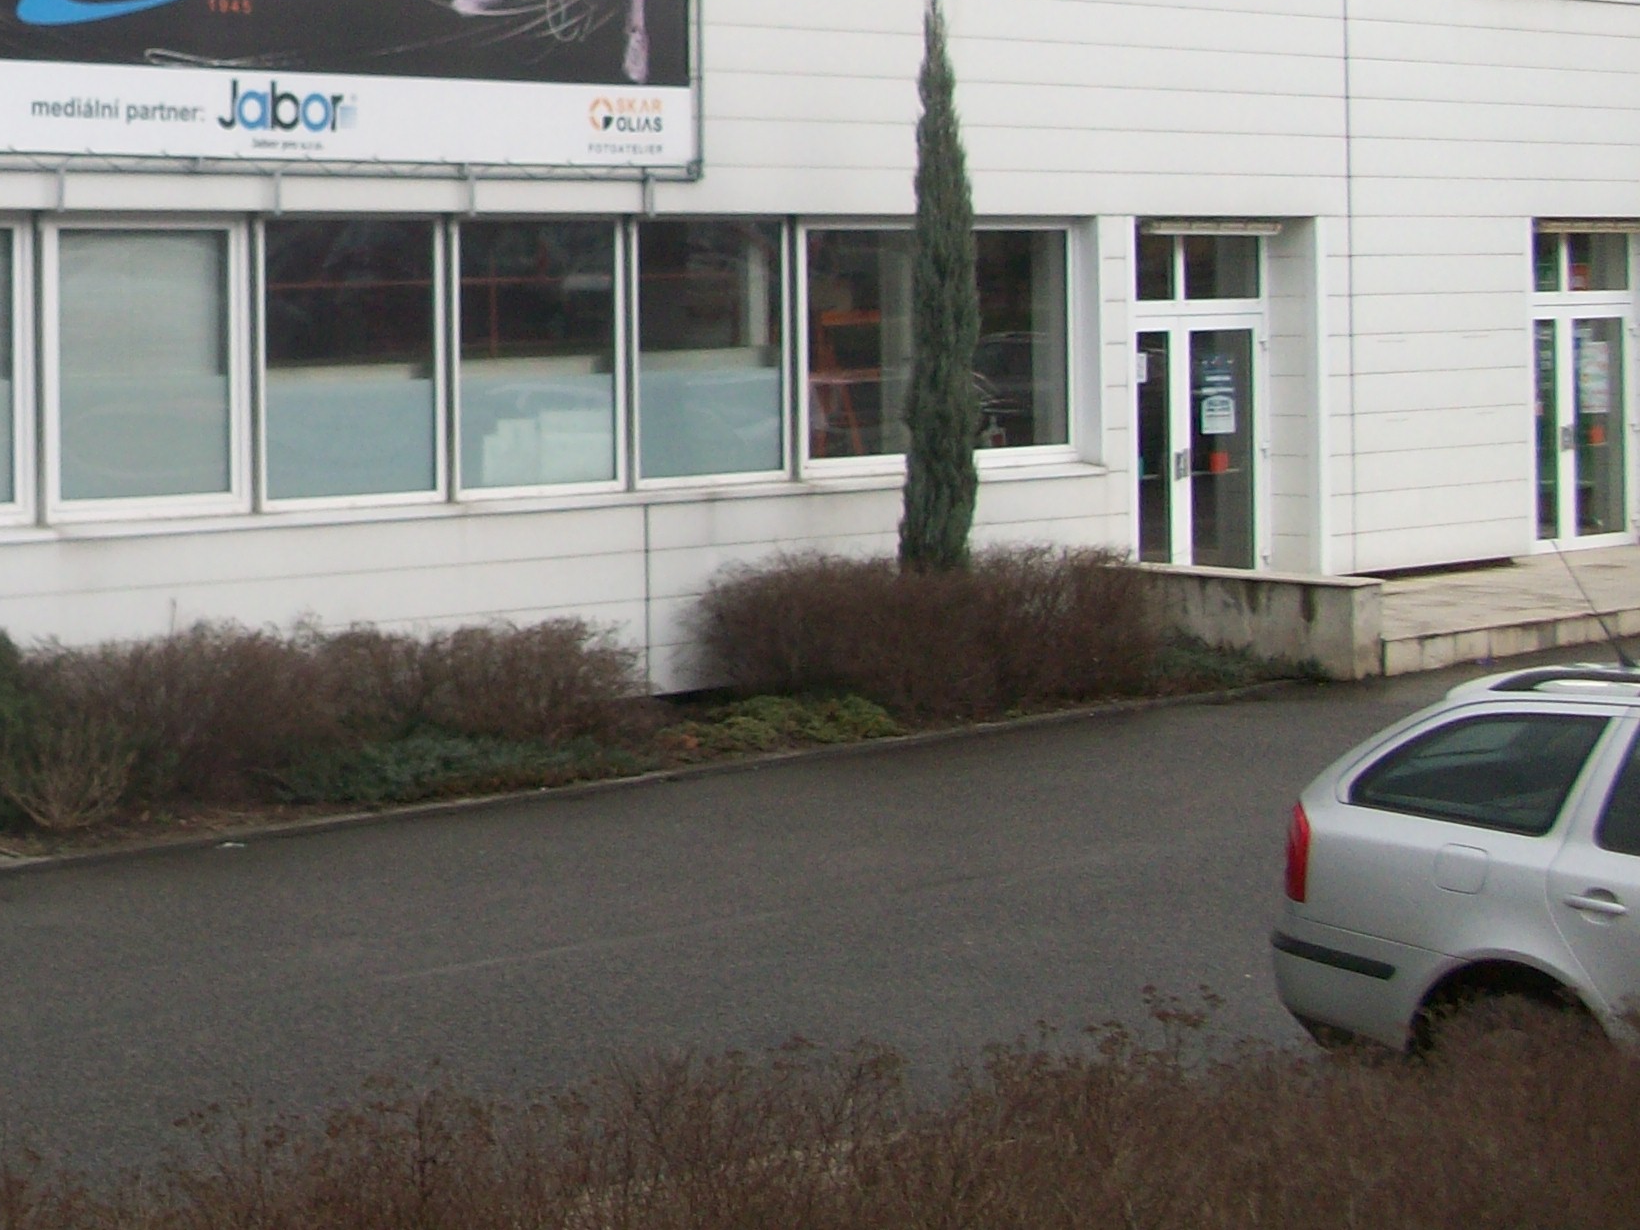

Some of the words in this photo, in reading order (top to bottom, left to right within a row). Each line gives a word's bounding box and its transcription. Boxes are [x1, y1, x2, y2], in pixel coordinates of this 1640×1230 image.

[30, 97, 120, 120] mediální
[218, 78, 344, 133] Jabor
[616, 116, 664, 132] OLIAS
